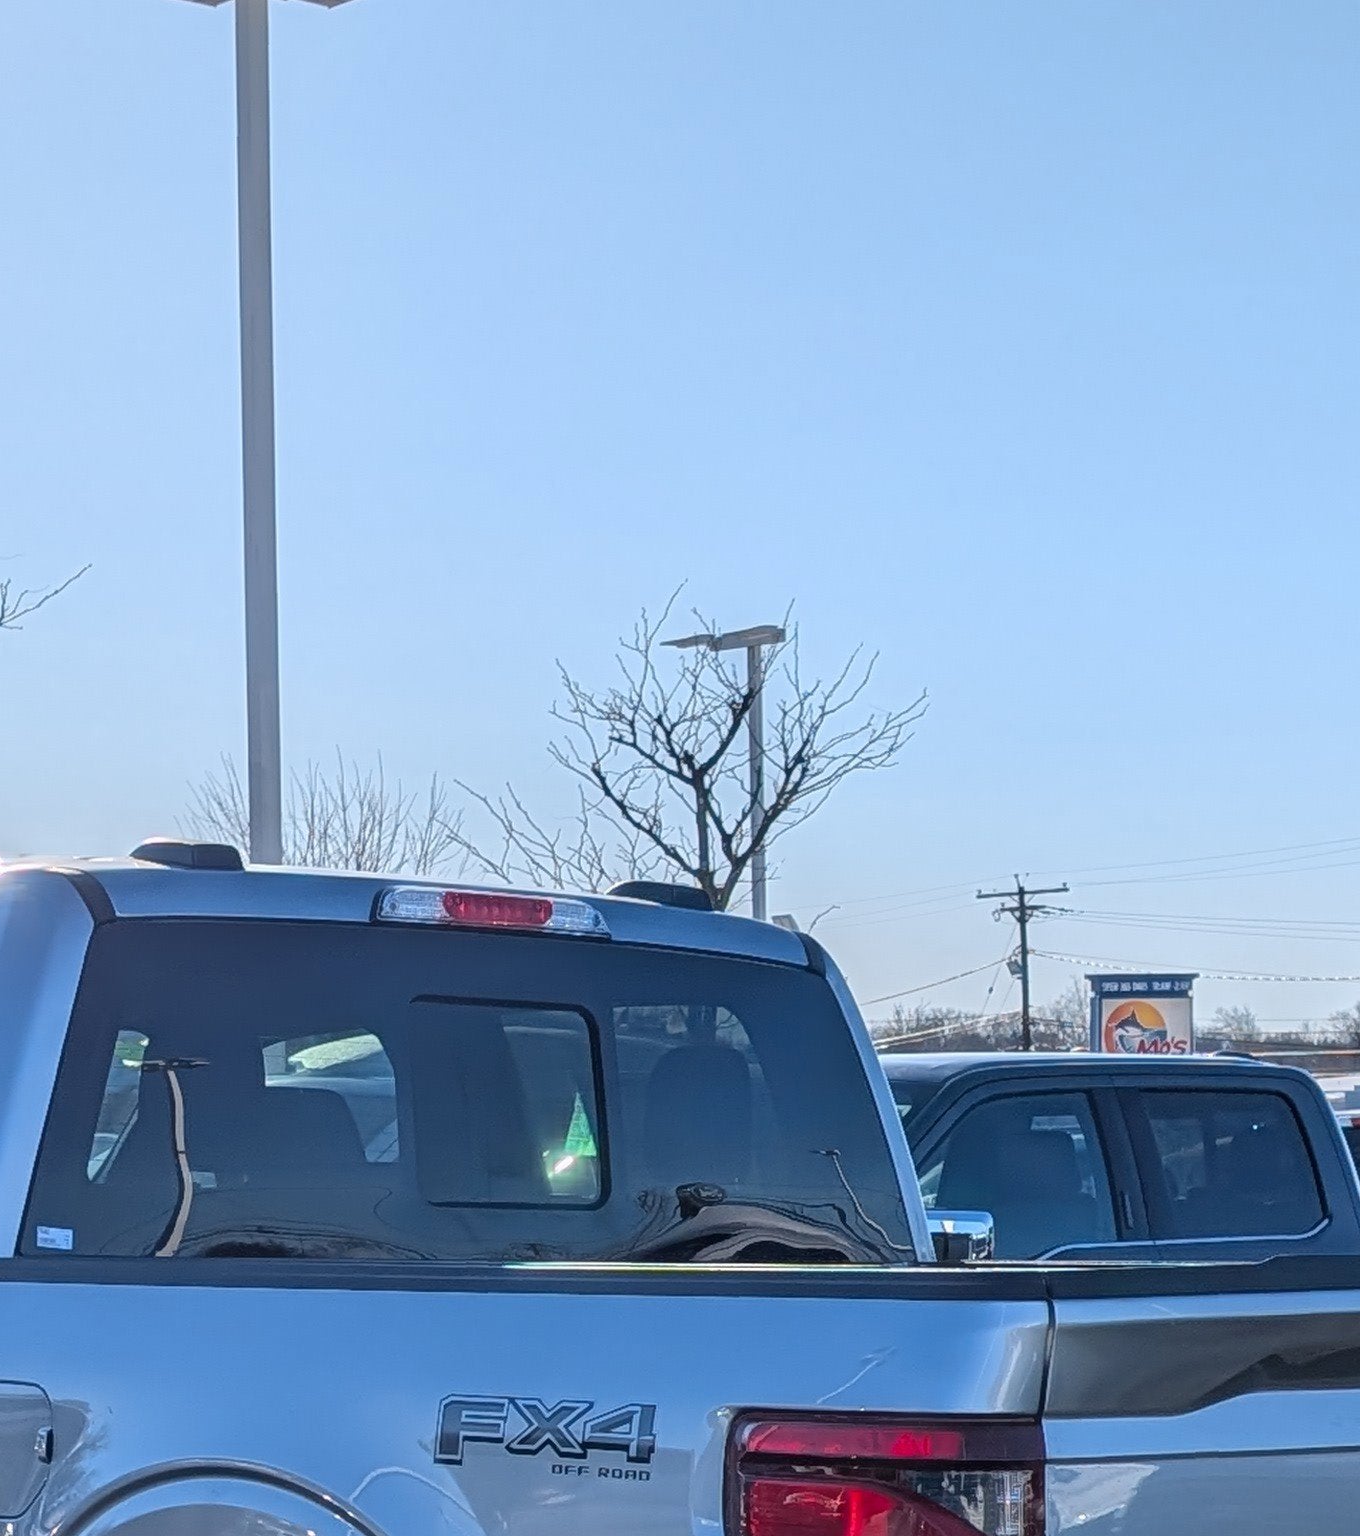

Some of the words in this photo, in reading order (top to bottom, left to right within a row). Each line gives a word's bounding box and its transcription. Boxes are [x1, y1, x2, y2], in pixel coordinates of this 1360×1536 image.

[433, 1393, 657, 1466] FX4
[551, 1463, 590, 1477] OFF
[598, 1467, 652, 1481] ROAD
